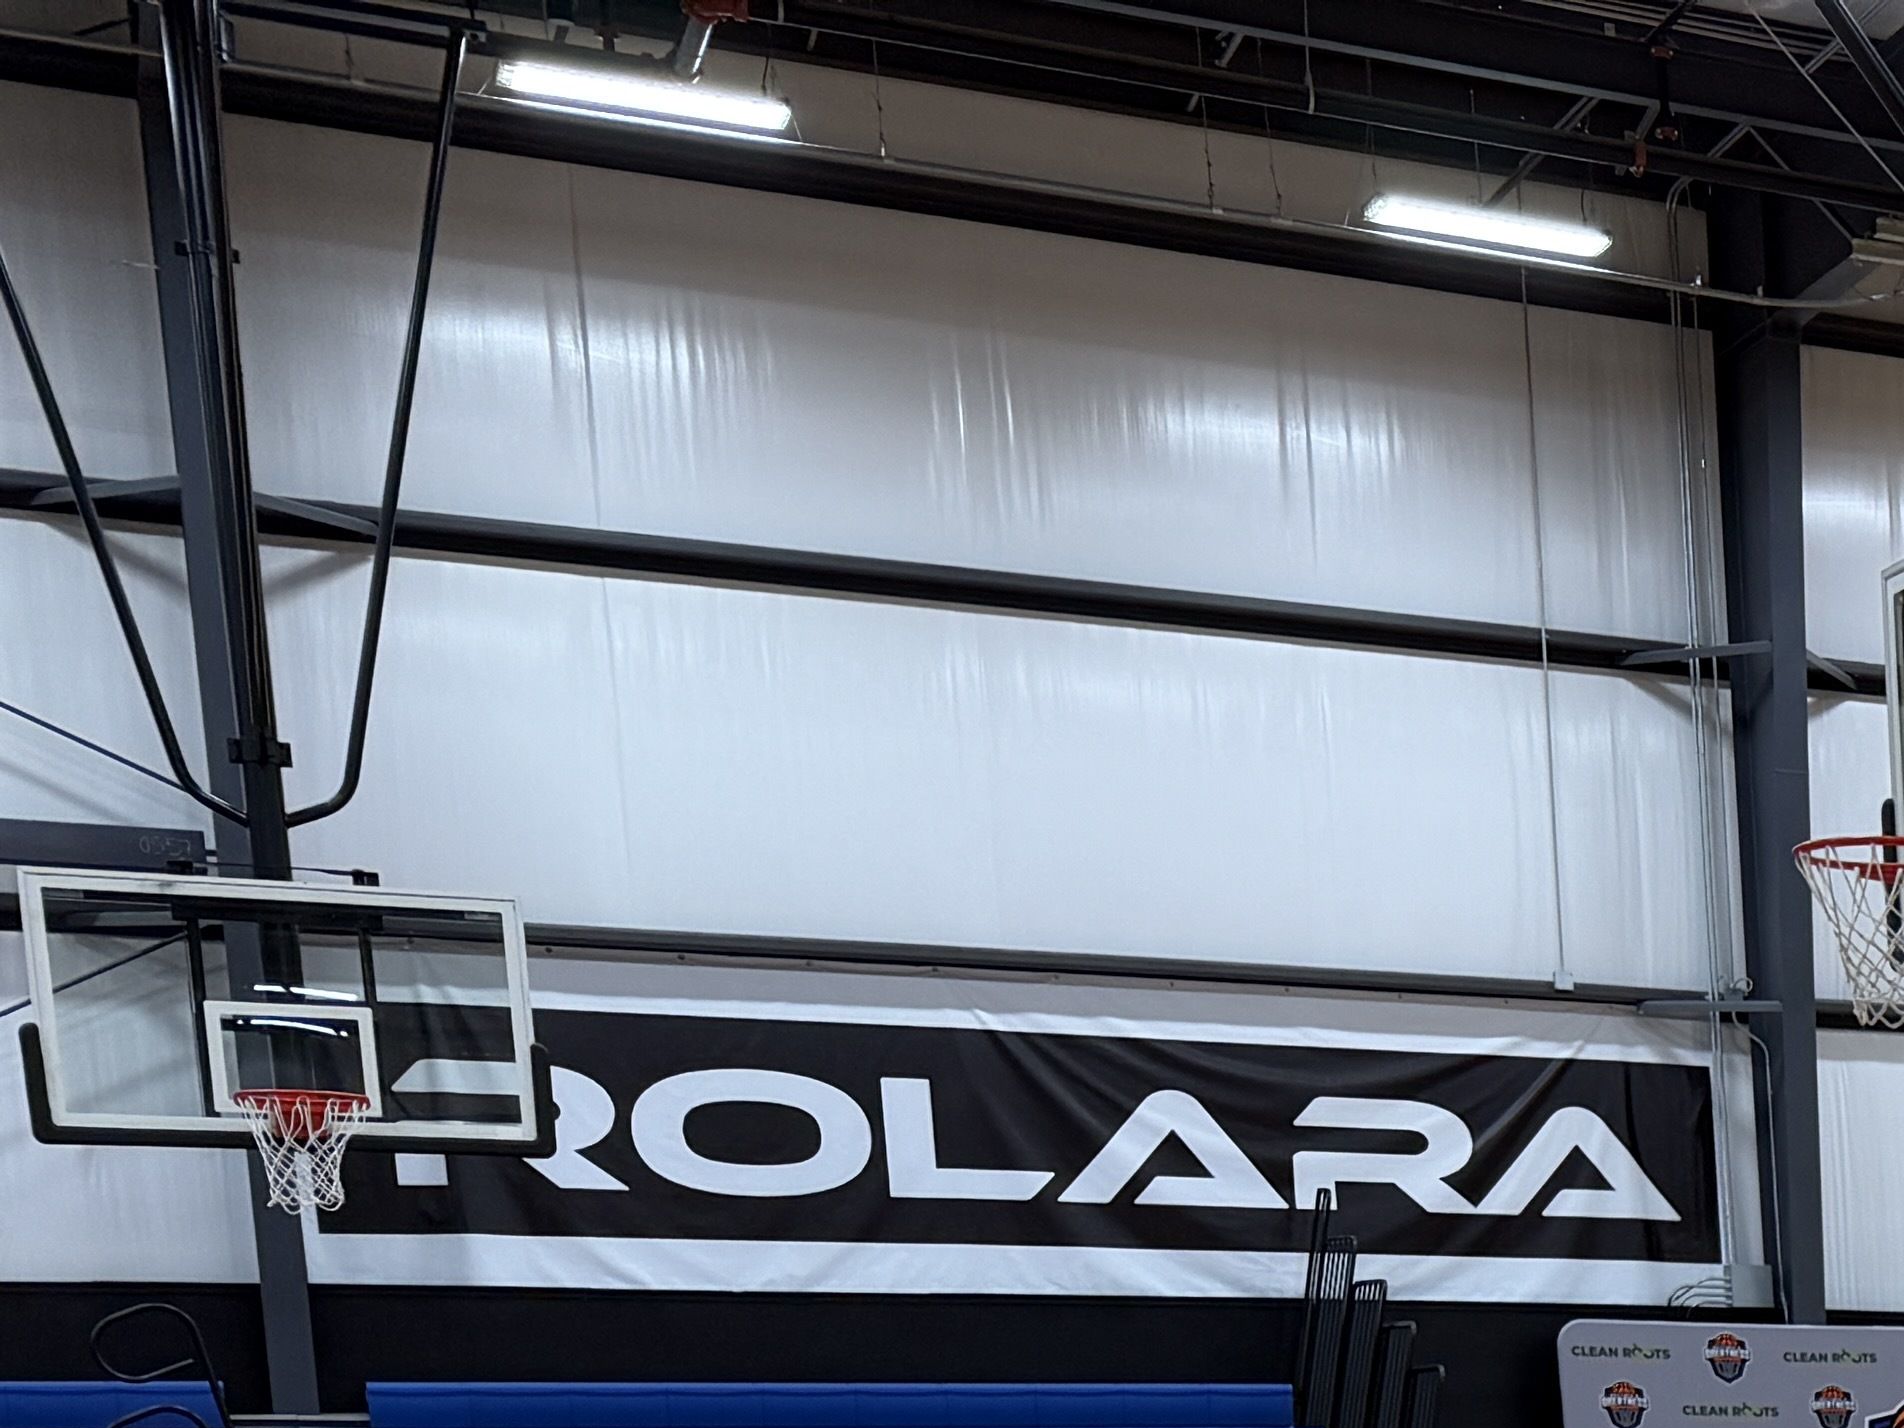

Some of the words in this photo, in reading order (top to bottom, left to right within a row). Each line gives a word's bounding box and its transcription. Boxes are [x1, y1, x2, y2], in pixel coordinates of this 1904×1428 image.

[1572, 1346, 1618, 1358] CLEAN
[1784, 1352, 1828, 1363] CLEAN
[1682, 1405, 1728, 1416] CLEAN
